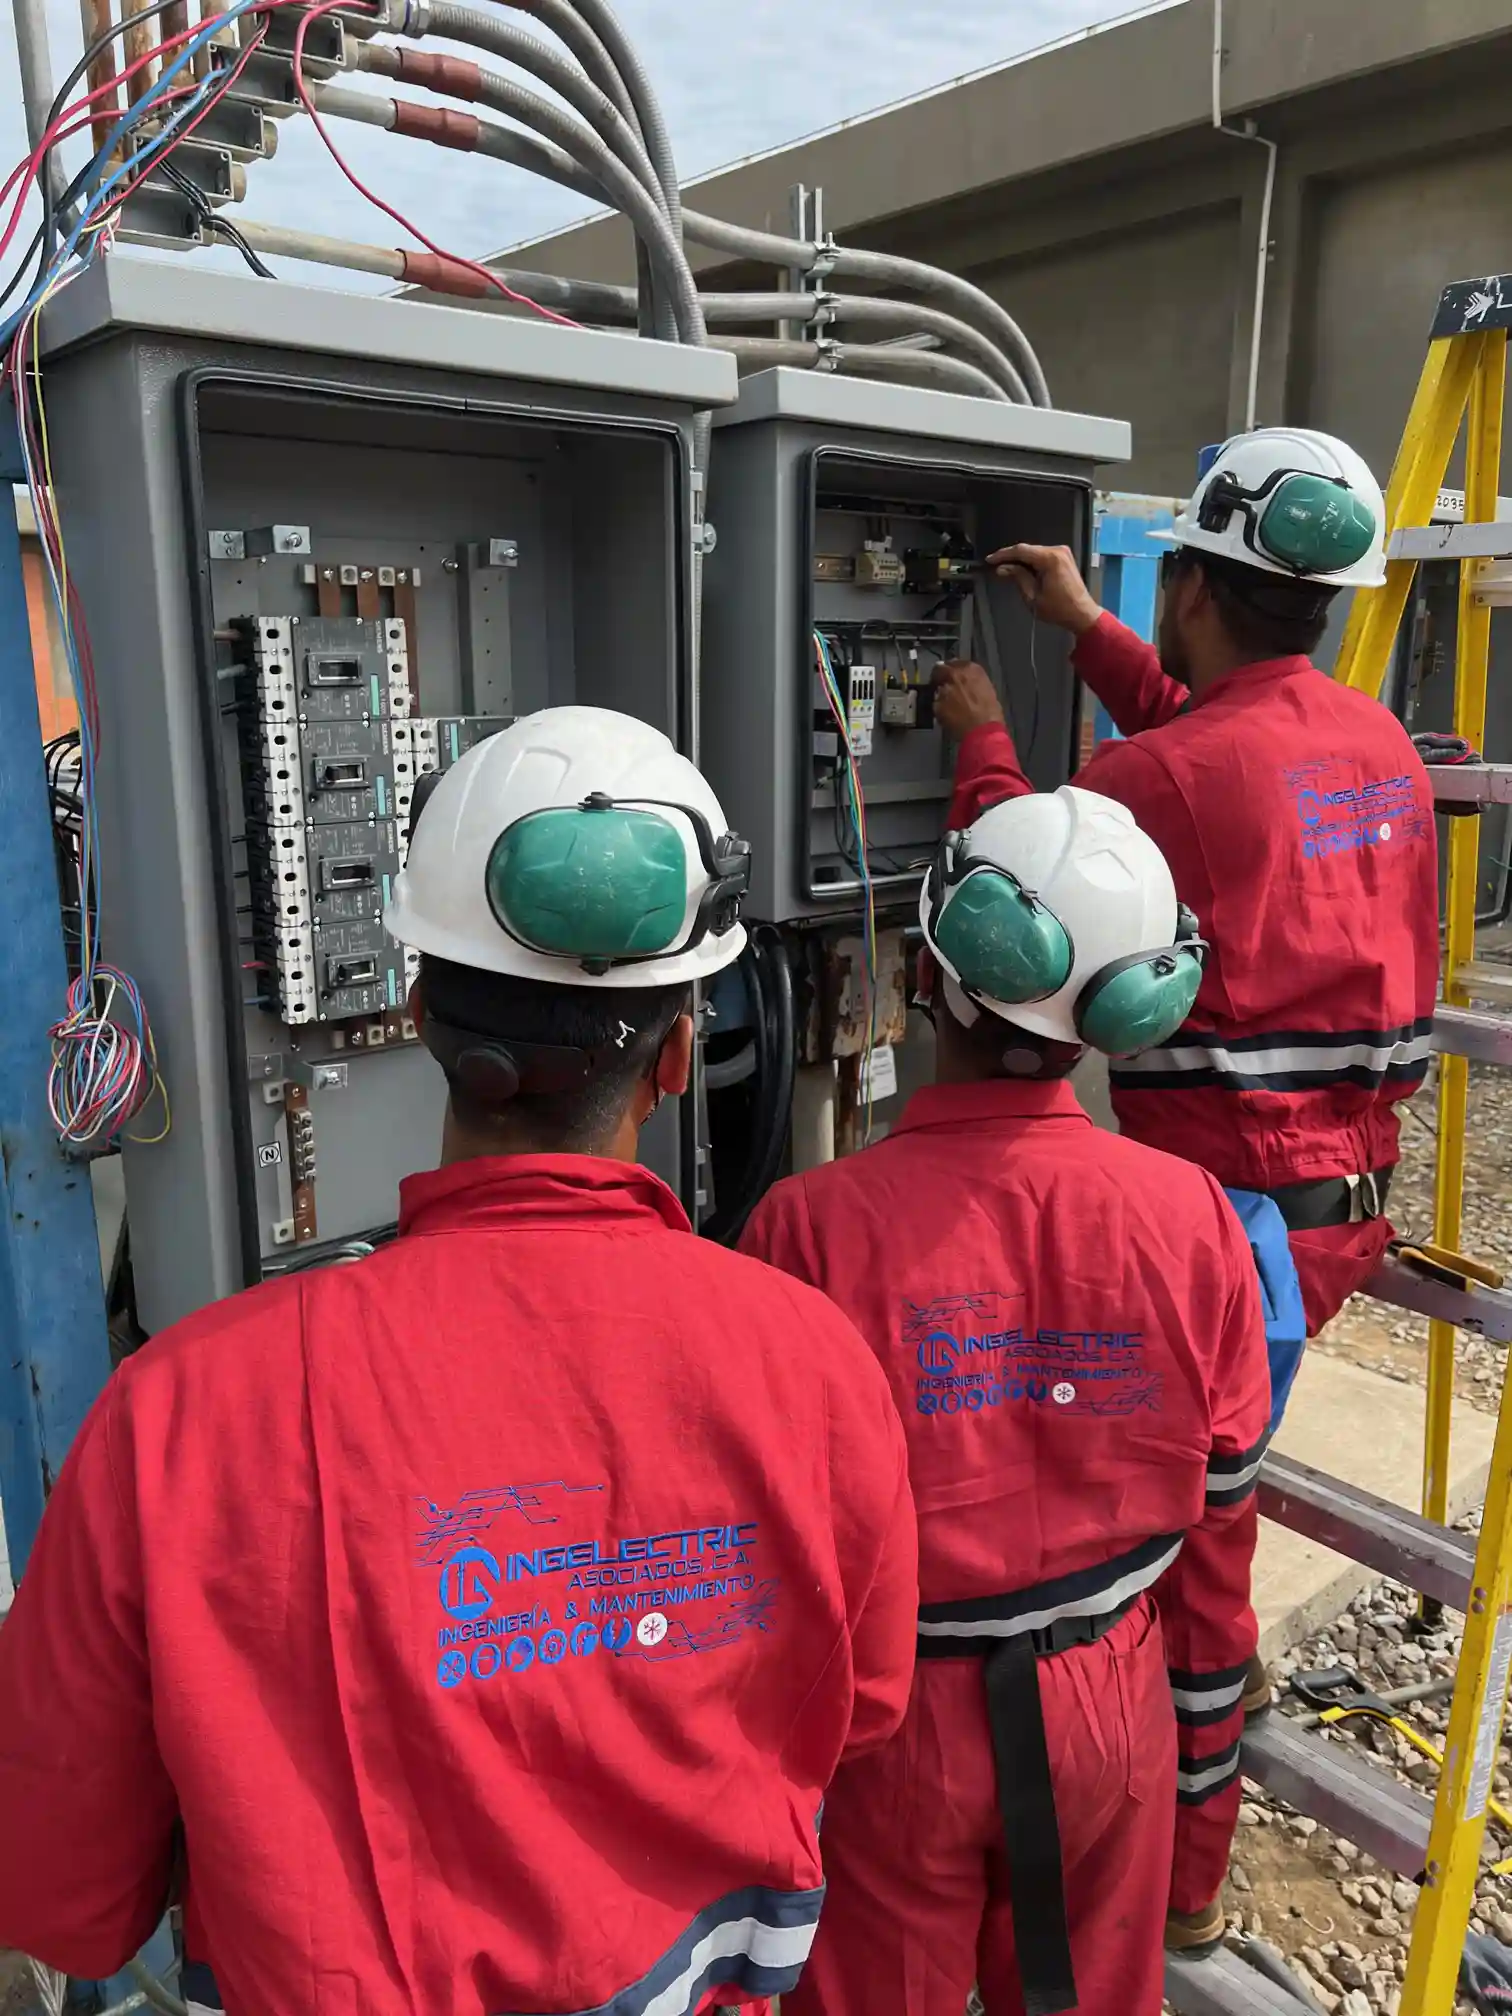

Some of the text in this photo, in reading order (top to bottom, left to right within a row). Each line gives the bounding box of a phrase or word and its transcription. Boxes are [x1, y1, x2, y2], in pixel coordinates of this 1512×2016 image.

[375, 620, 383, 653] SIEMENS
[381, 723, 389, 755] SIEMENS
[506, 1522, 757, 1582] INGELECTRIC
[565, 1601, 579, 1619] &
[590, 1574, 755, 1616] MANTENIMIENTO
